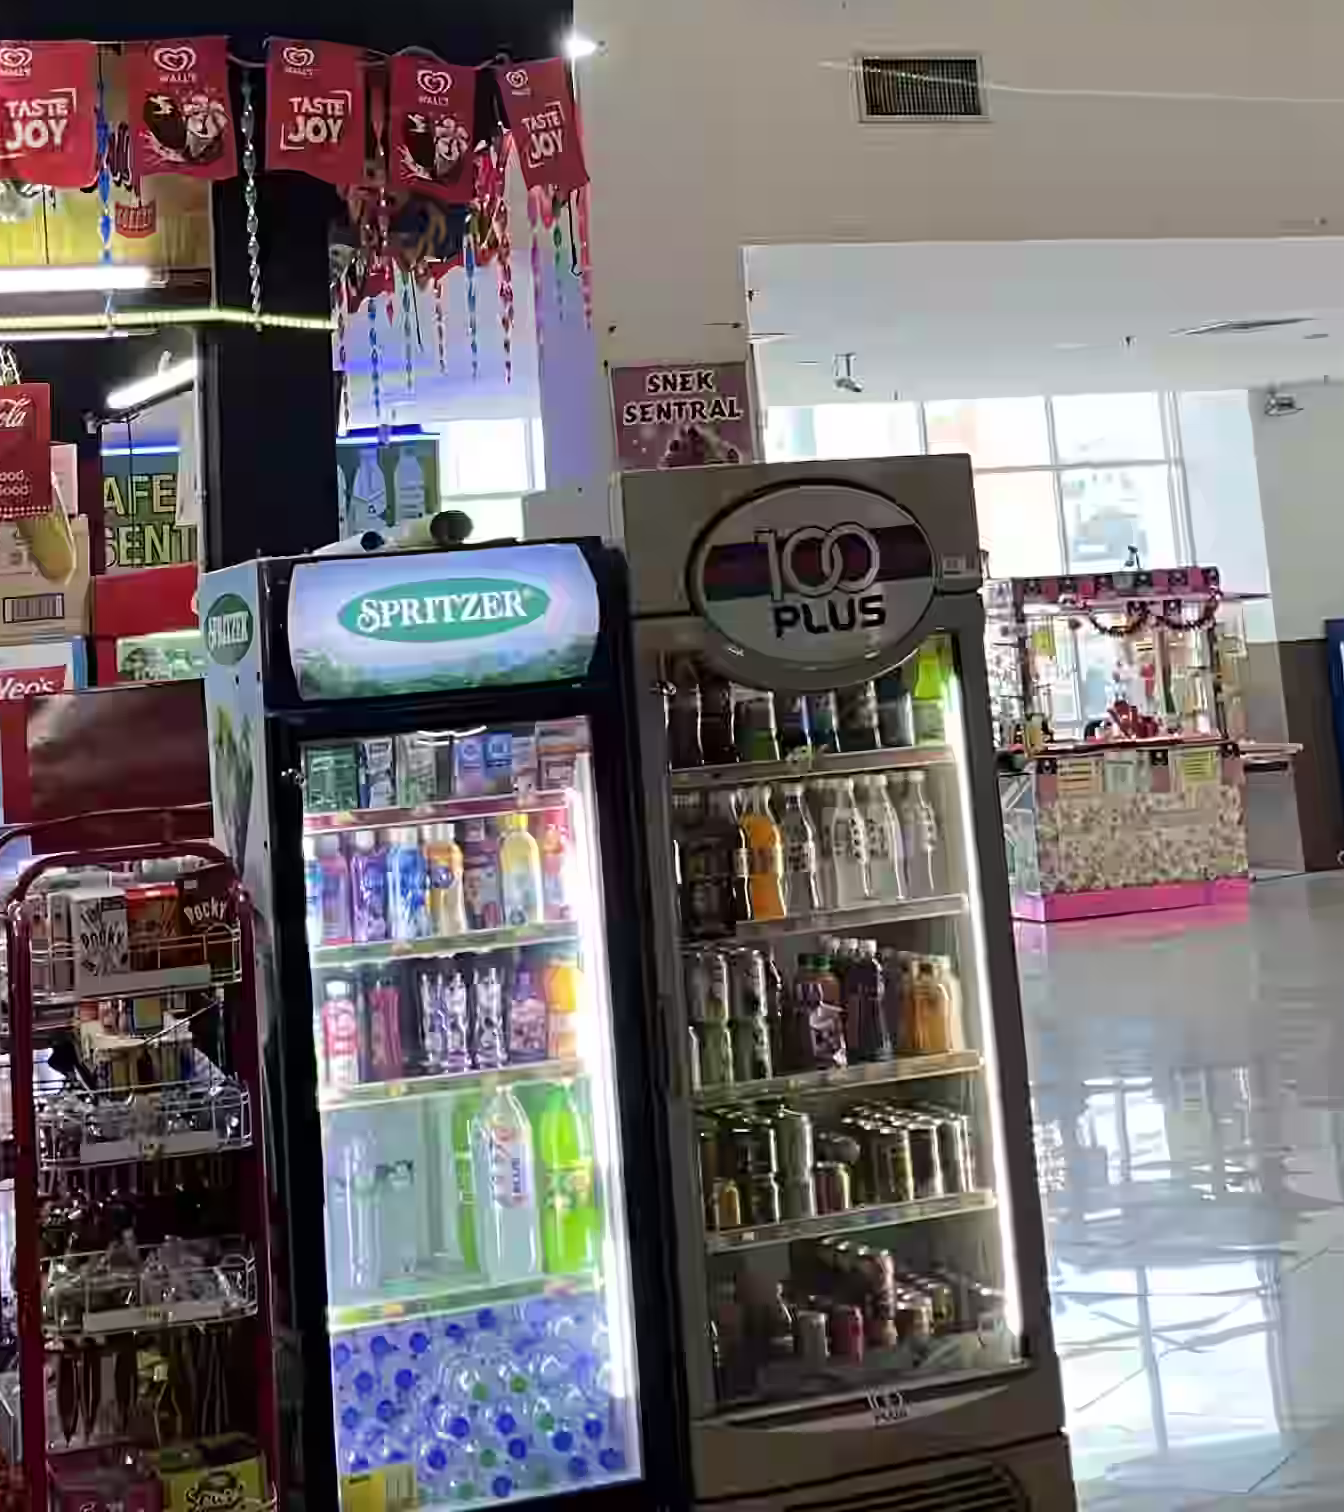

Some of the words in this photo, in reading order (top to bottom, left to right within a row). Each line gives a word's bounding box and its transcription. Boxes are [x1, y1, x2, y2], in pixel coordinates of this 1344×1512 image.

[3, 98, 70, 120] TASTE
[288, 96, 345, 117] TASTE
[522, 110, 562, 132] TASTE
[4, 119, 69, 152] JOY
[287, 116, 345, 144] JOY
[528, 128, 564, 160] JOY
[646, 369, 716, 395] SNEK
[622, 396, 744, 426] SENTRAL
[752, 521, 881, 602] 100
[357, 590, 528, 633] SPRITZER
[772, 593, 887, 639] PLUS
